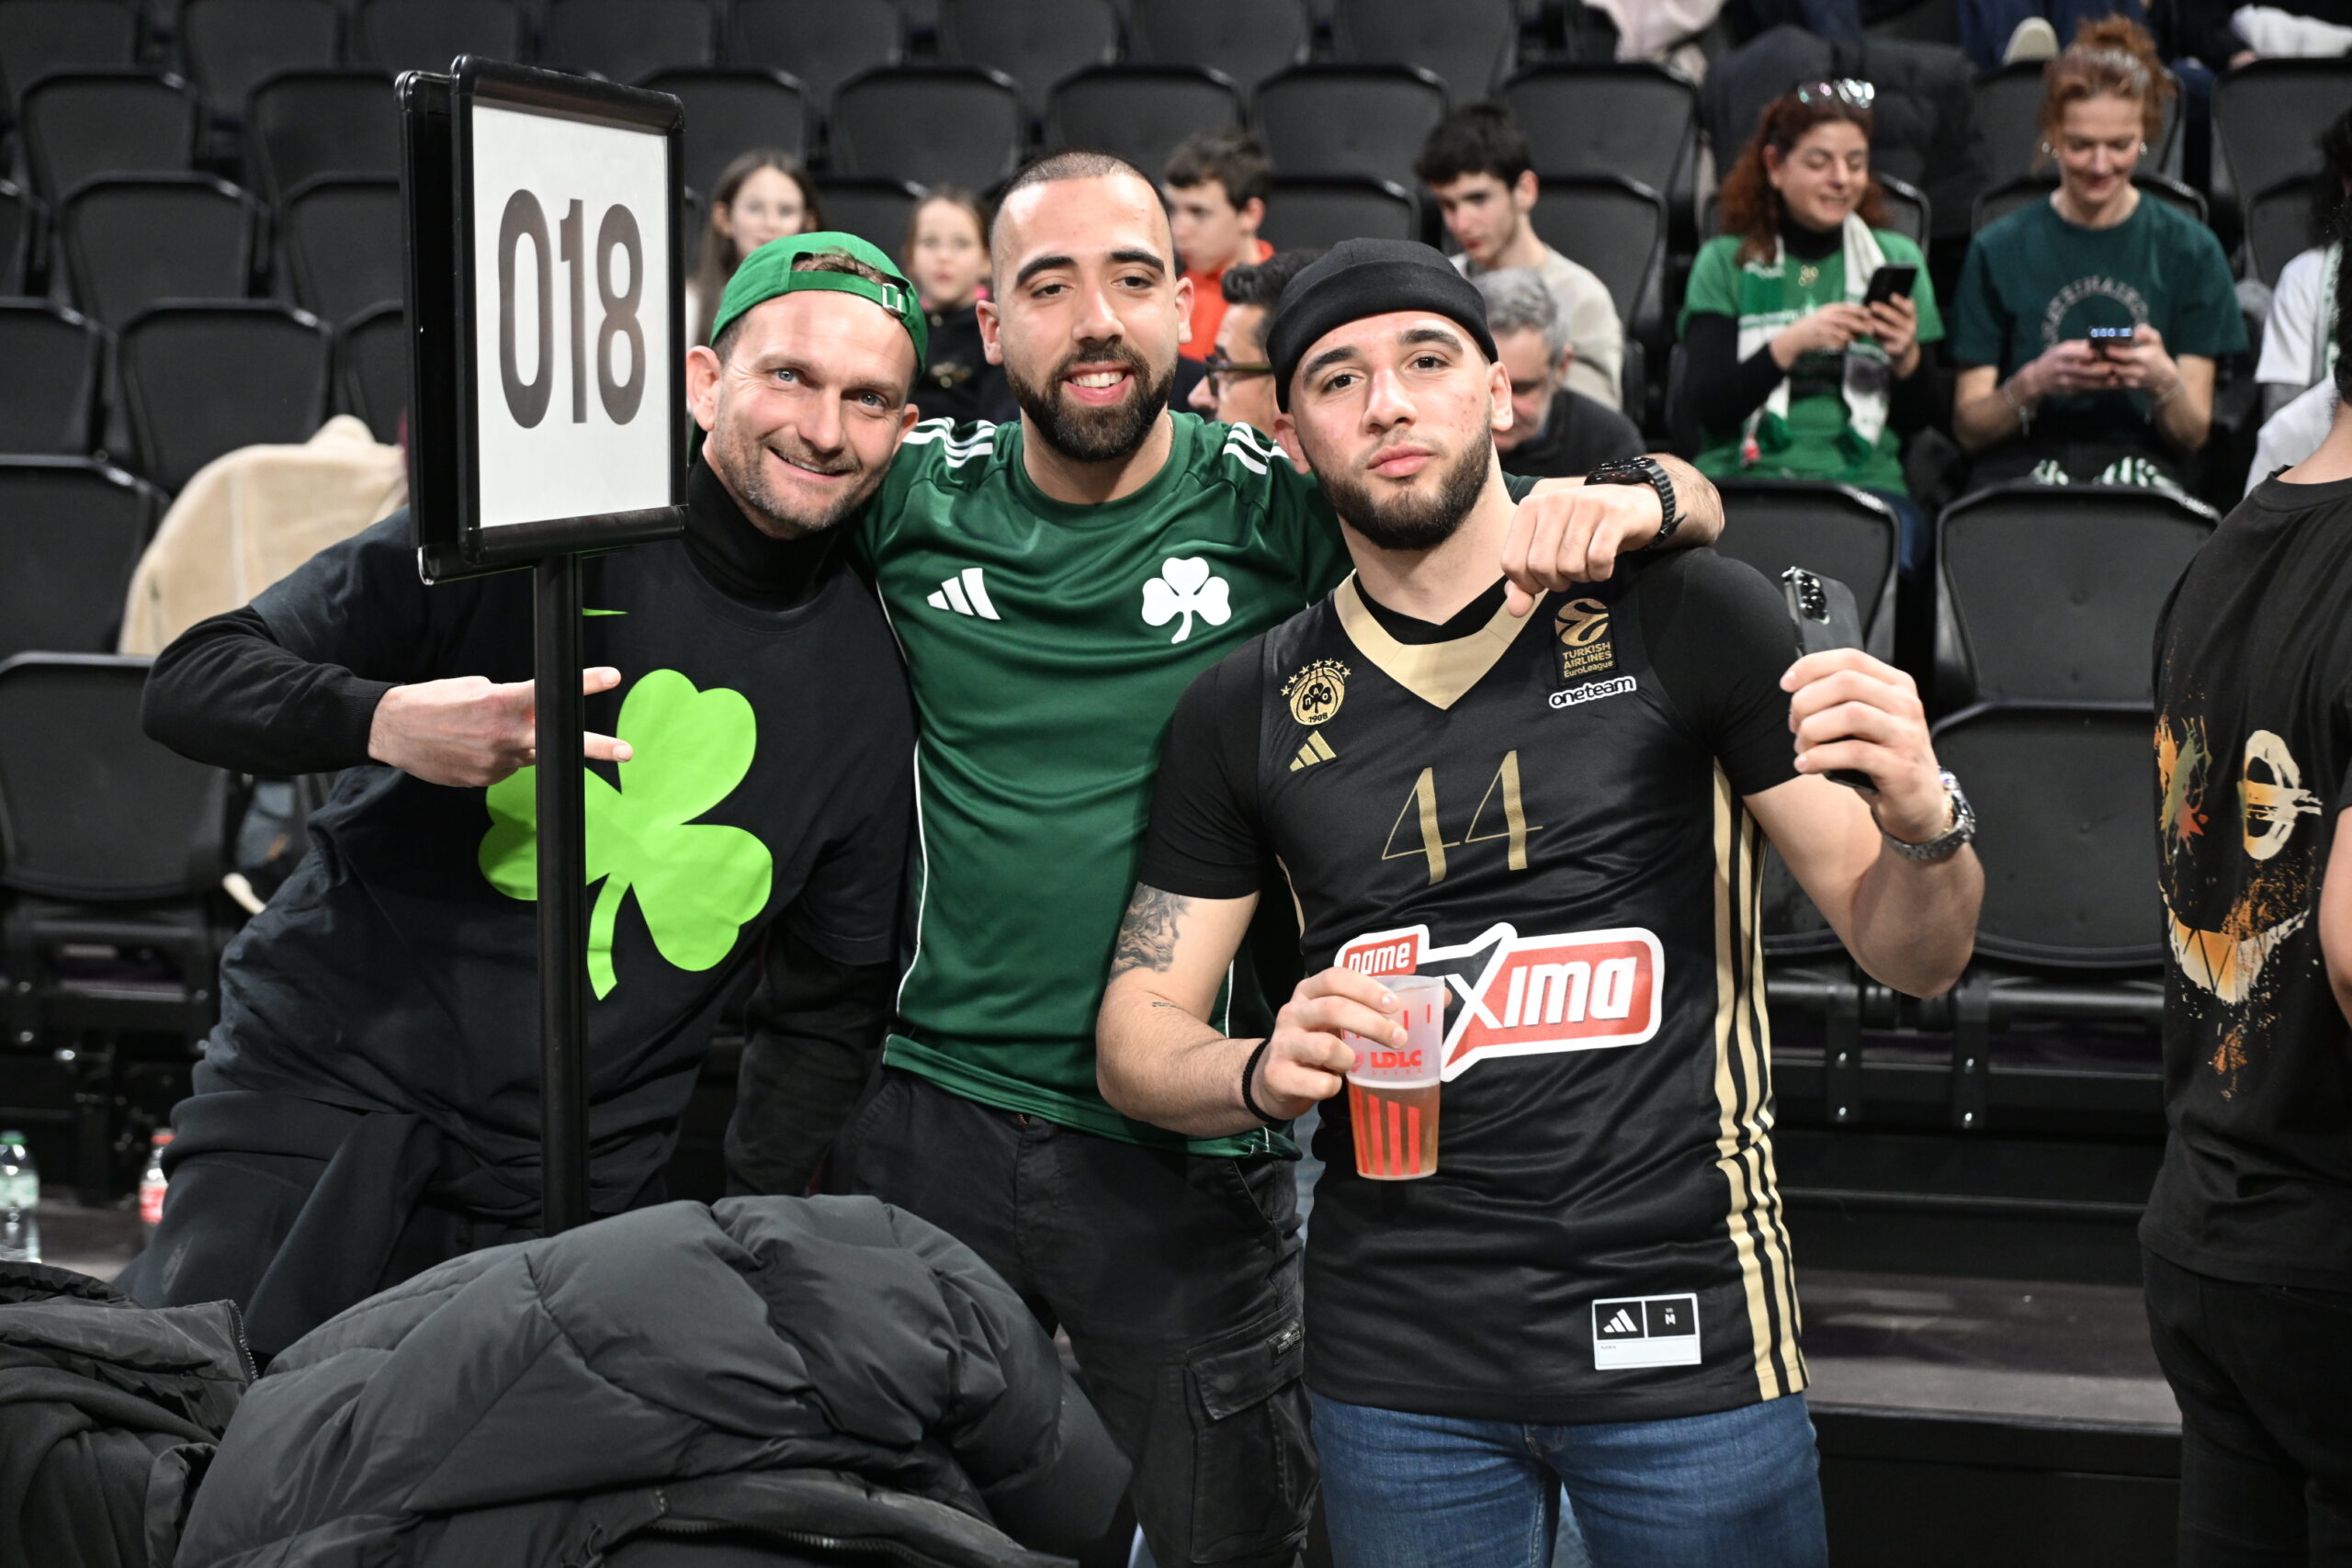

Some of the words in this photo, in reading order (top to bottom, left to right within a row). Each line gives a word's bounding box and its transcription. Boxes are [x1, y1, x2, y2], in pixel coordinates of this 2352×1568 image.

[498, 188, 647, 429] 018
[1563, 641, 1611, 660] TURKISH
[1564, 650, 1612, 670] AIRLINES
[1564, 660, 1613, 678] EuroLeague
[1552, 678, 1634, 705] oneteam
[1308, 712, 1329, 723] 1908
[1382, 750, 1544, 885] 44
[1370, 1049, 1422, 1068] LDLC
